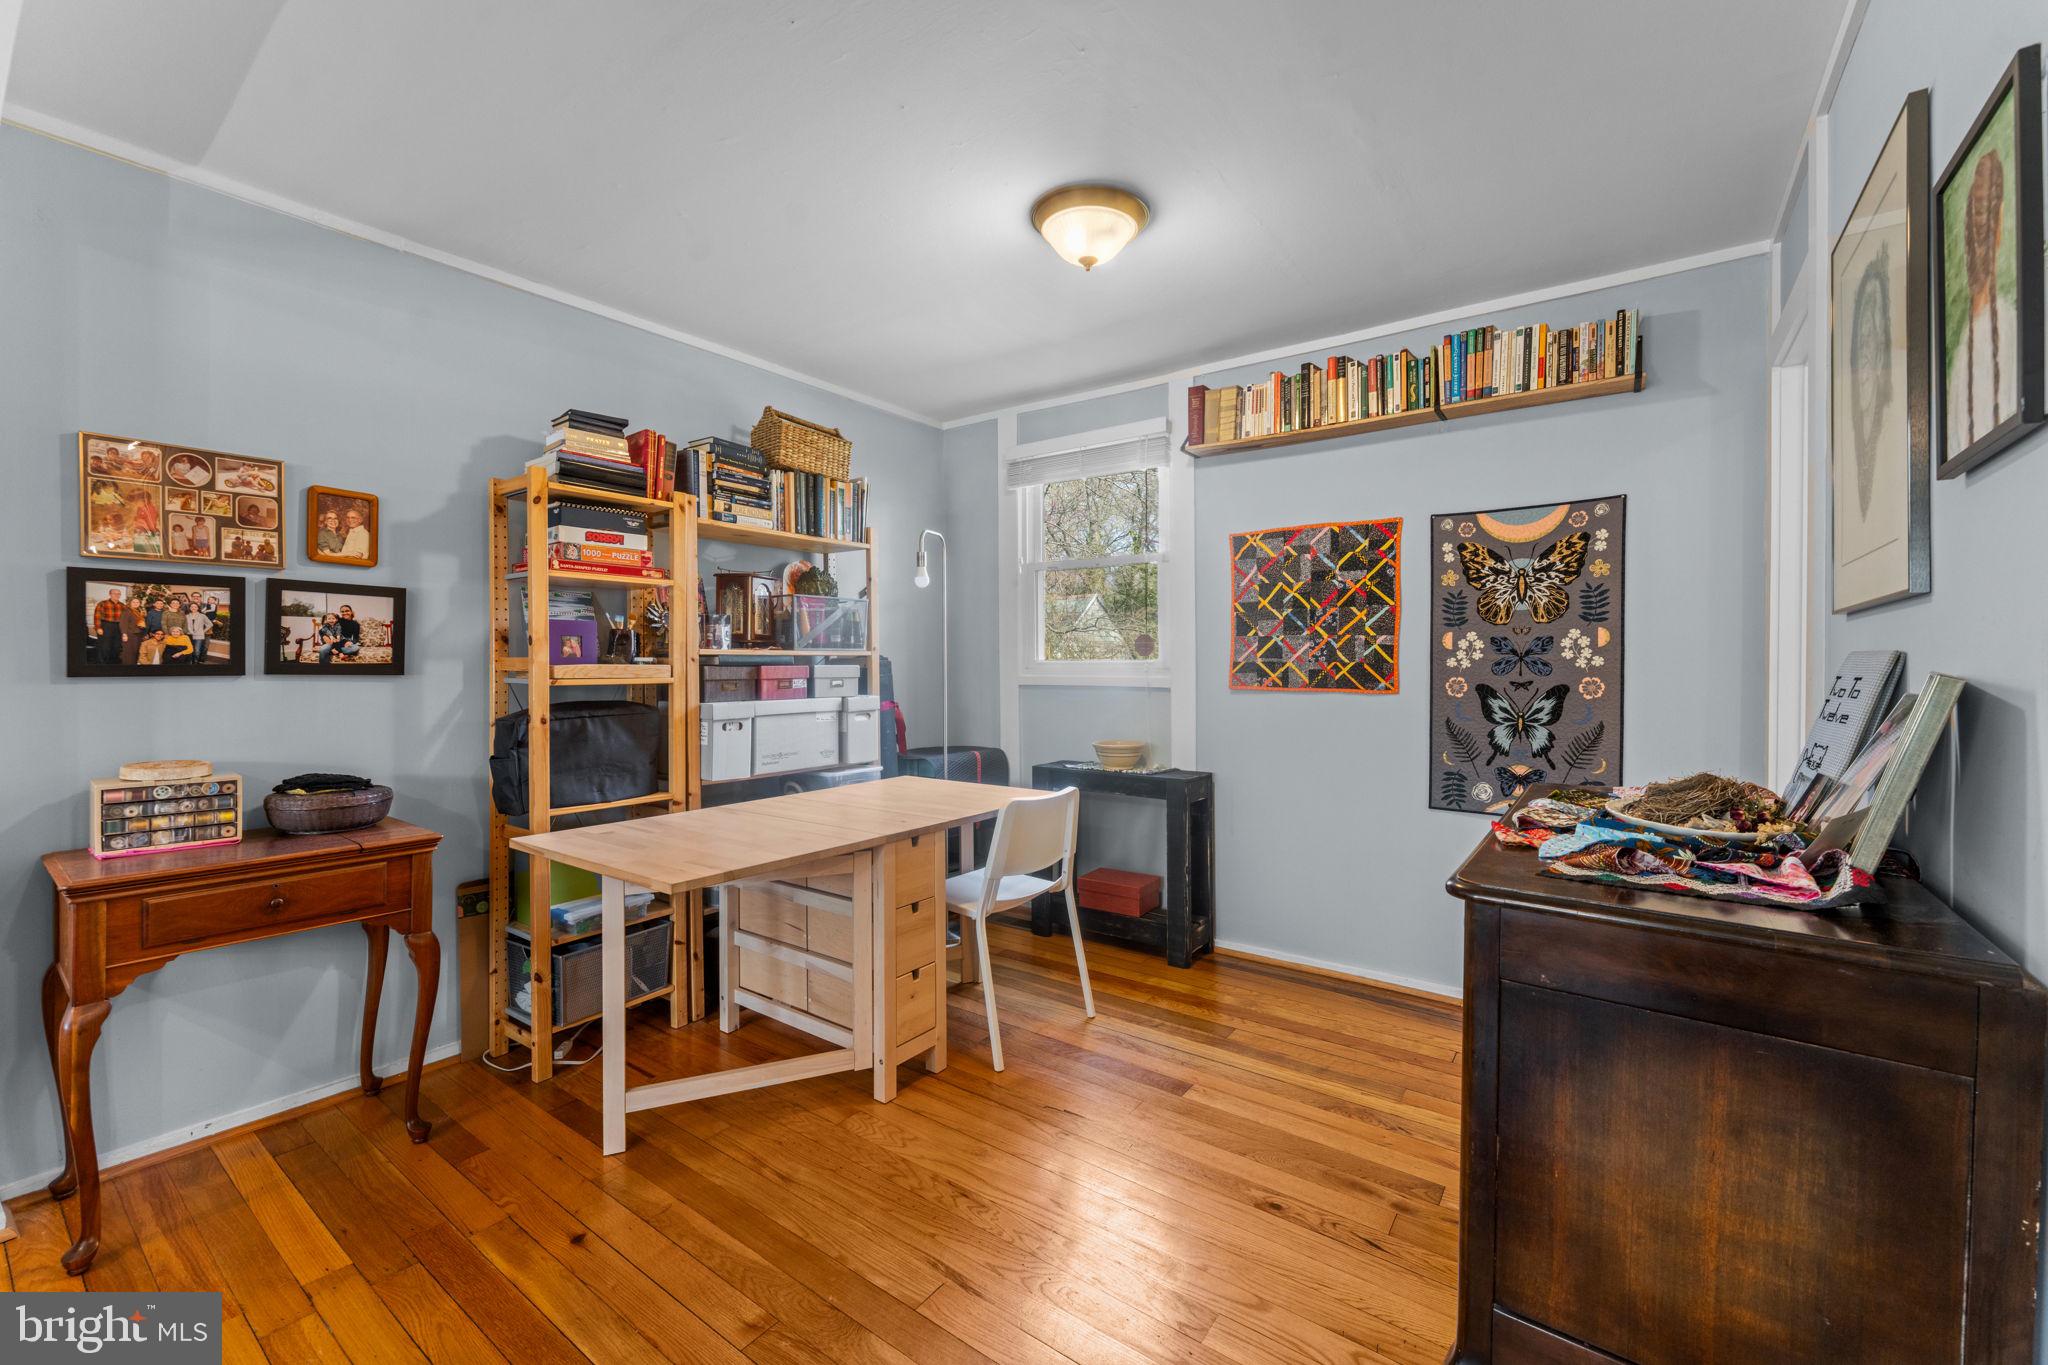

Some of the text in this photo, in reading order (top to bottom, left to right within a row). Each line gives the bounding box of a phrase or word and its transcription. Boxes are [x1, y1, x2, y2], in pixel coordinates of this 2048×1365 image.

[582, 548, 602, 557] 1000
[611, 551, 640, 561] PUZZLE
[1829, 675, 1863, 699] Two To
[1818, 699, 1850, 725] Twelve
